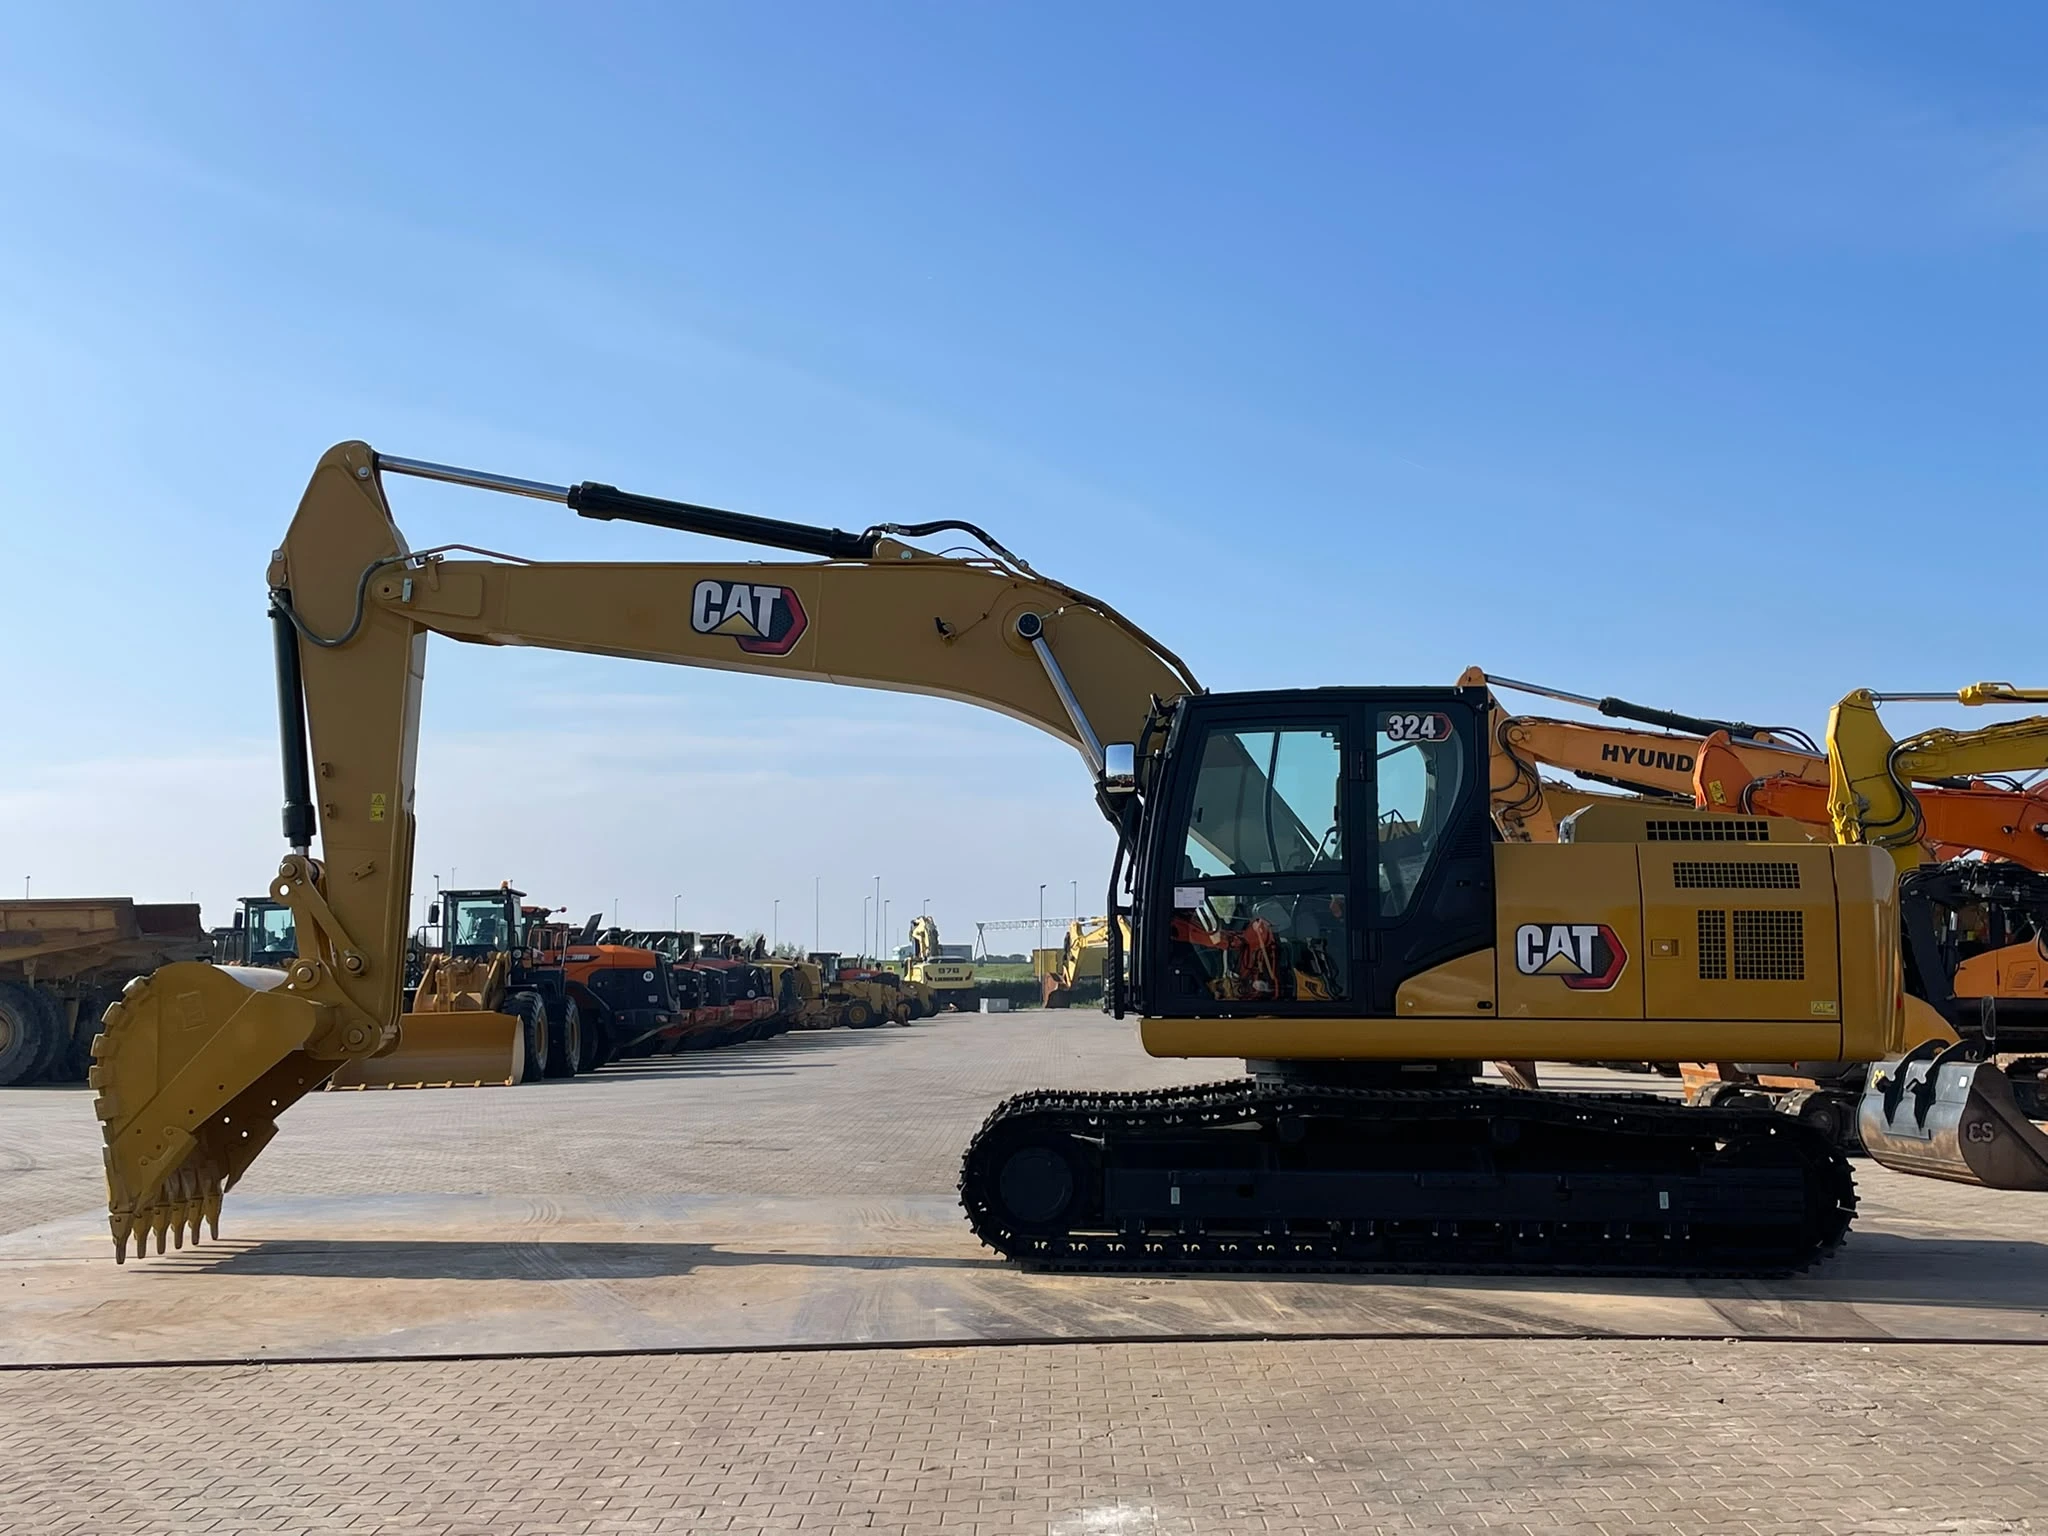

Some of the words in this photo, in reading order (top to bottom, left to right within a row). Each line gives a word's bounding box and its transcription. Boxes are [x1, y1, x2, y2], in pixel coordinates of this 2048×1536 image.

[692, 580, 781, 637] CAT
[1388, 714, 1436, 740] 324
[1517, 925, 1599, 975] CAT
